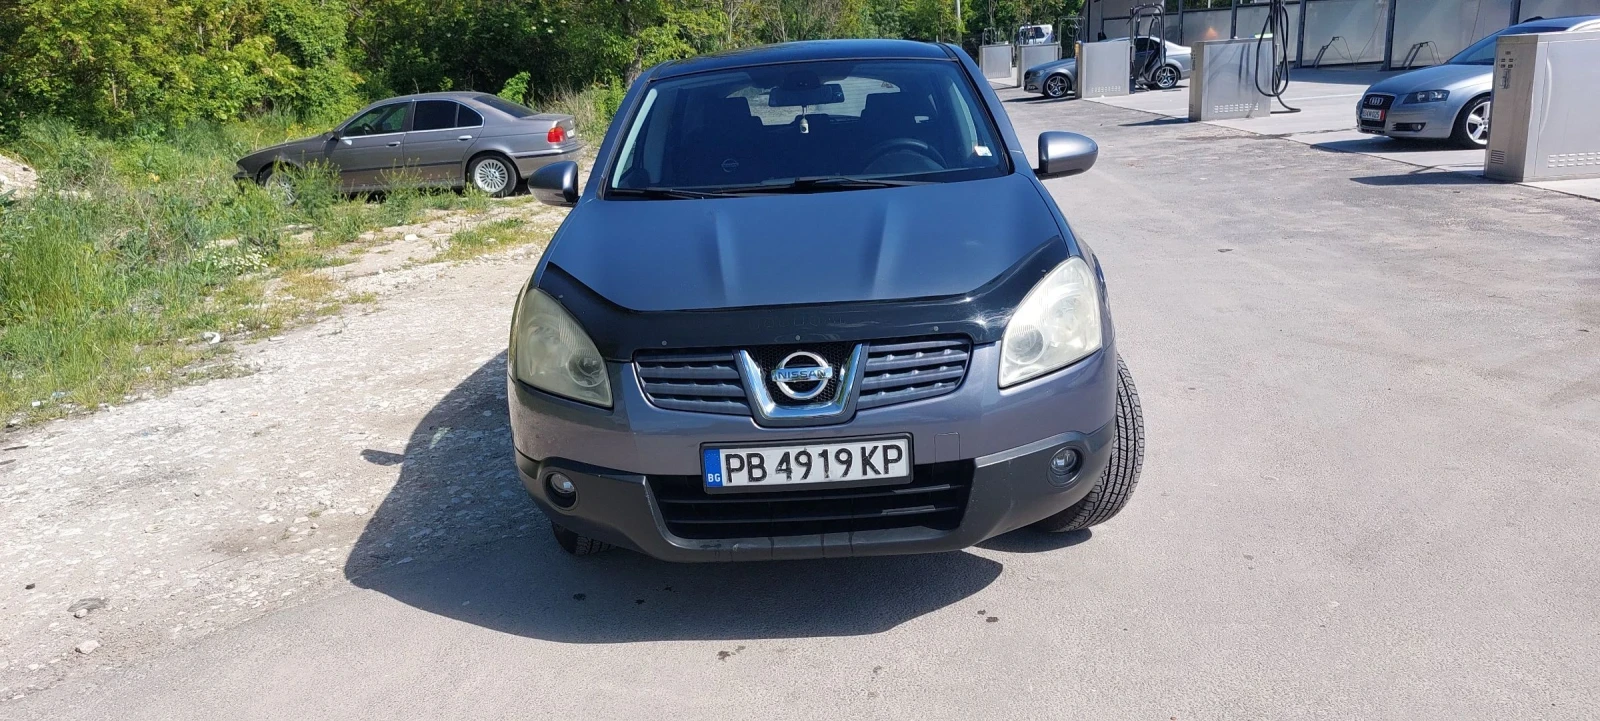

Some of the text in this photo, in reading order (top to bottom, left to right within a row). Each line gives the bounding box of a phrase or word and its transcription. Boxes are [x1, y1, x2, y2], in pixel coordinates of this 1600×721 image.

[778, 370, 827, 379] NISSAN
[725, 444, 903, 484] PB 4919 KP
[707, 474, 721, 482] BG
